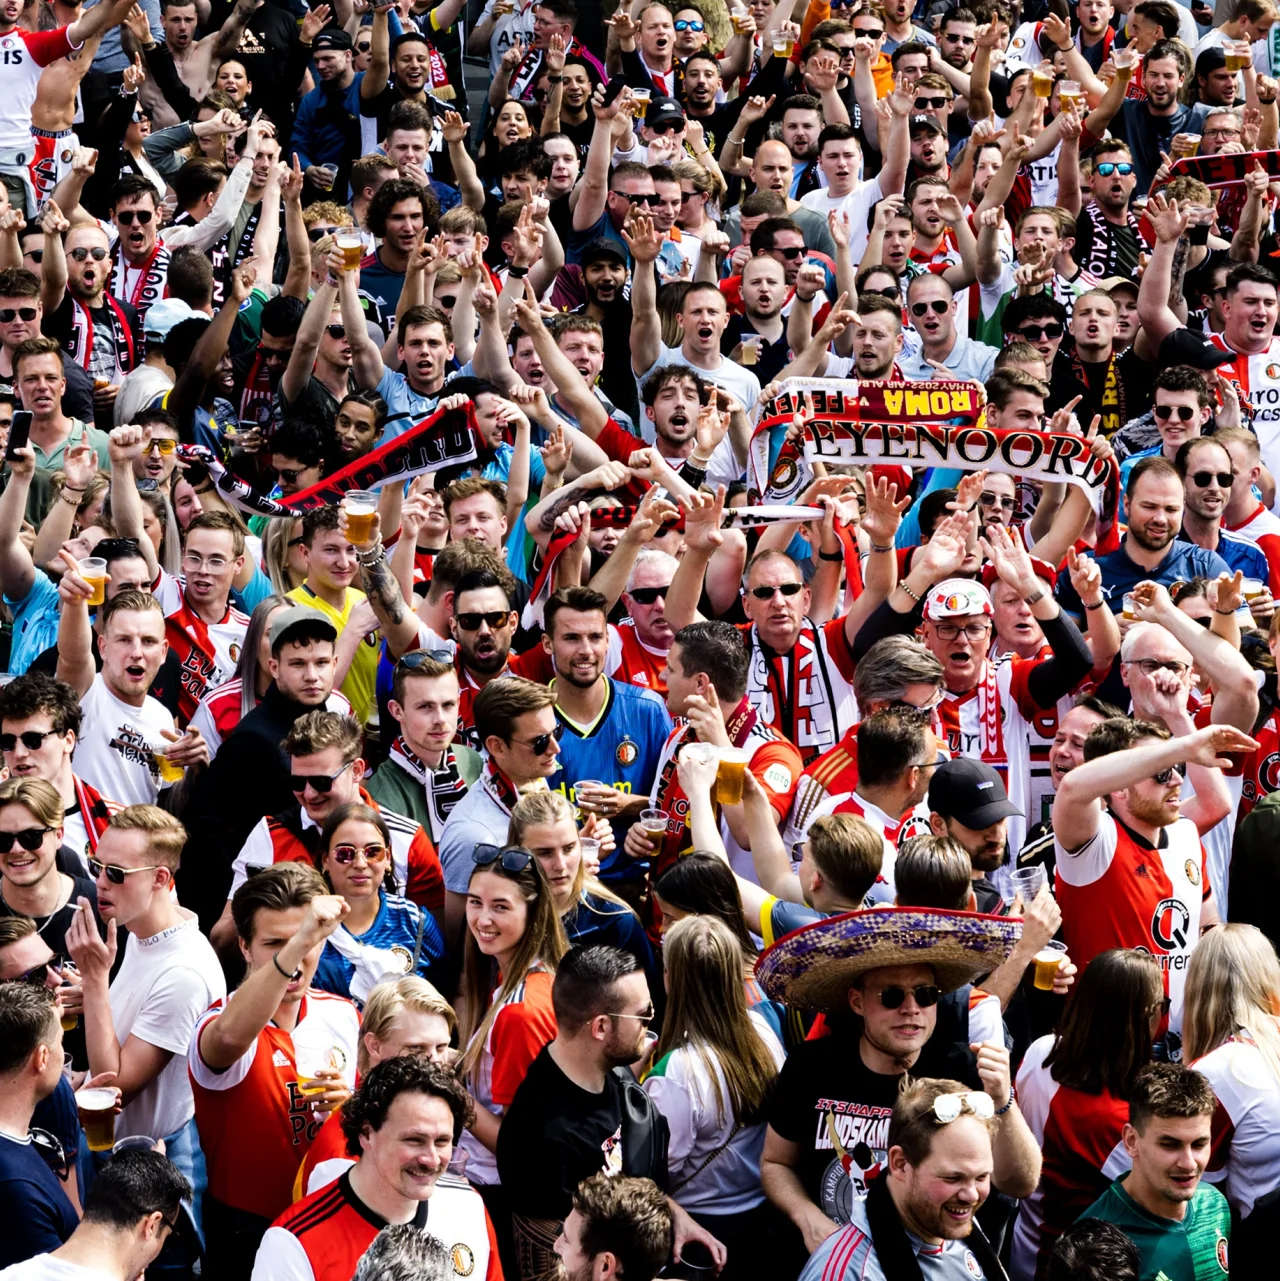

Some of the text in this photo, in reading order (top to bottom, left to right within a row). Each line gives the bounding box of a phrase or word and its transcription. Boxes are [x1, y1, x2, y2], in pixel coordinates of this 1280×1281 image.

[429, 53, 445, 83] 2022
[910, 380, 939, 391] 2022
[883, 389, 972, 417] ROMA
[806, 418, 1111, 488] EYENOORD
[767, 769, 790, 789] TOTO
[815, 1098, 846, 1113] IT'S
